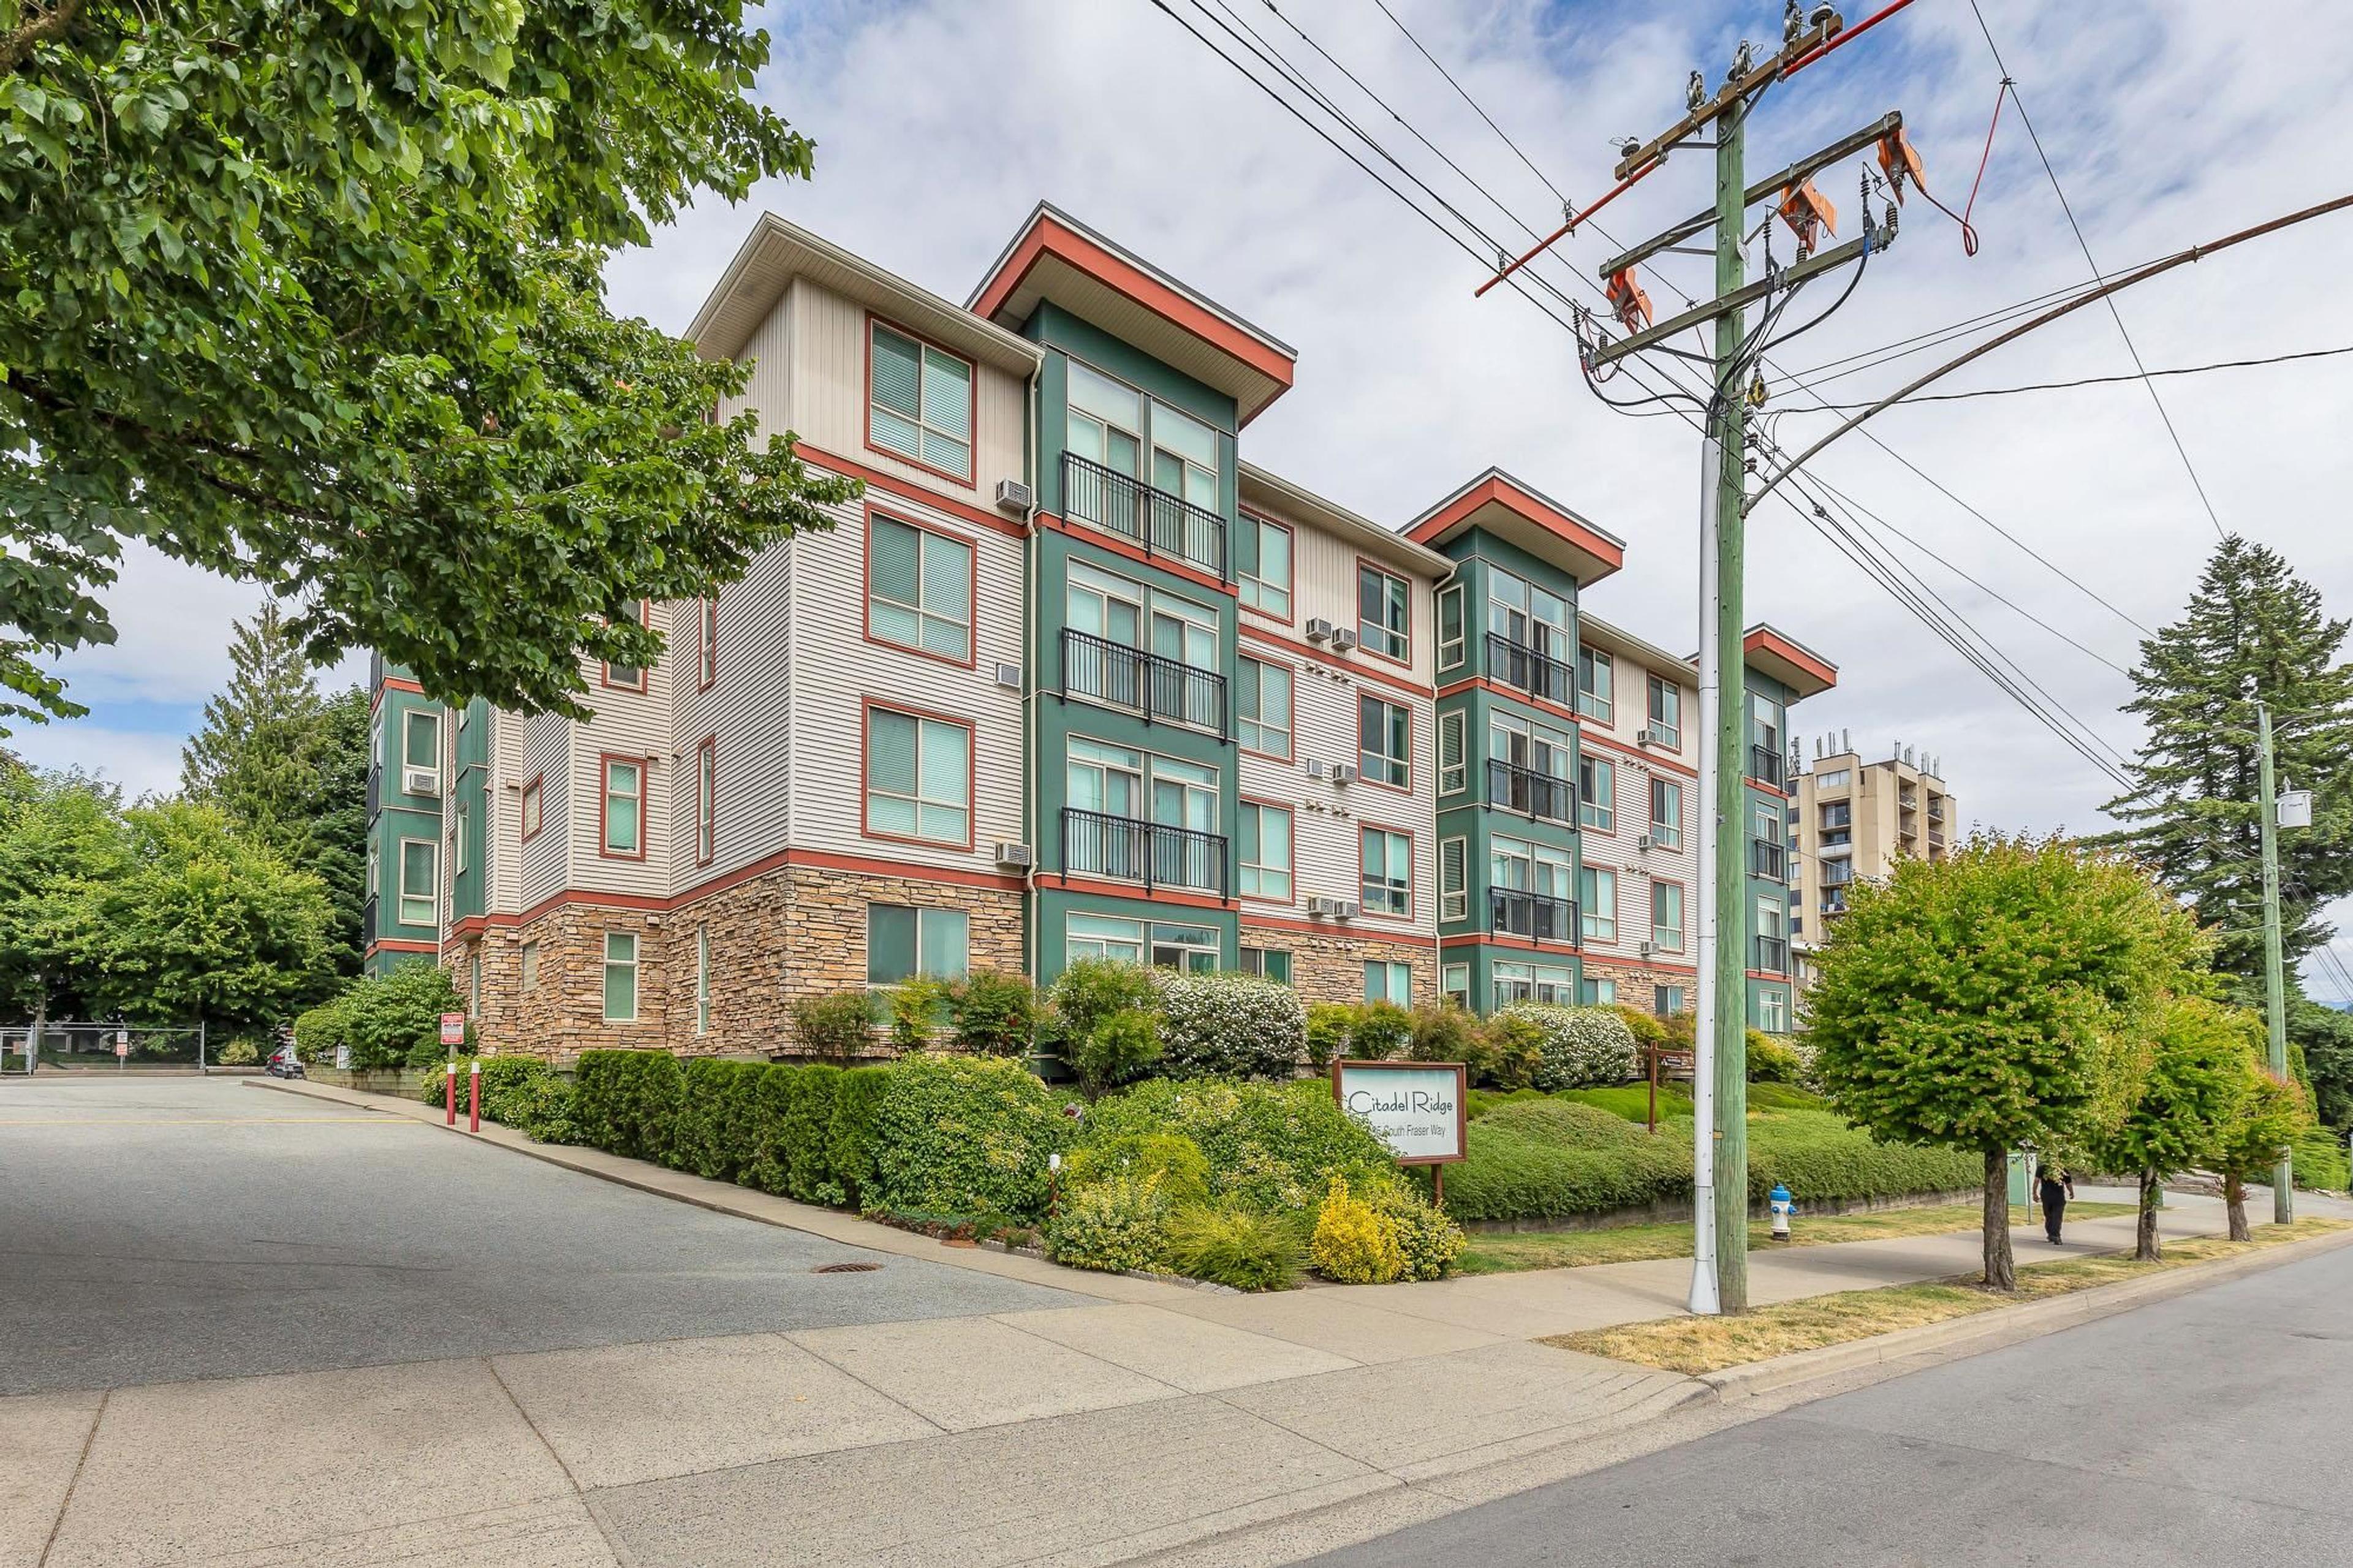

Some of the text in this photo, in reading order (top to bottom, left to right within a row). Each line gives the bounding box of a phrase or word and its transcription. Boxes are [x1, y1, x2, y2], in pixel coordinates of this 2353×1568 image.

[1348, 1091, 1453, 1115] Citadel Ridge
[1407, 1124, 1430, 1137] Fraser
[1430, 1124, 1446, 1137] Way
